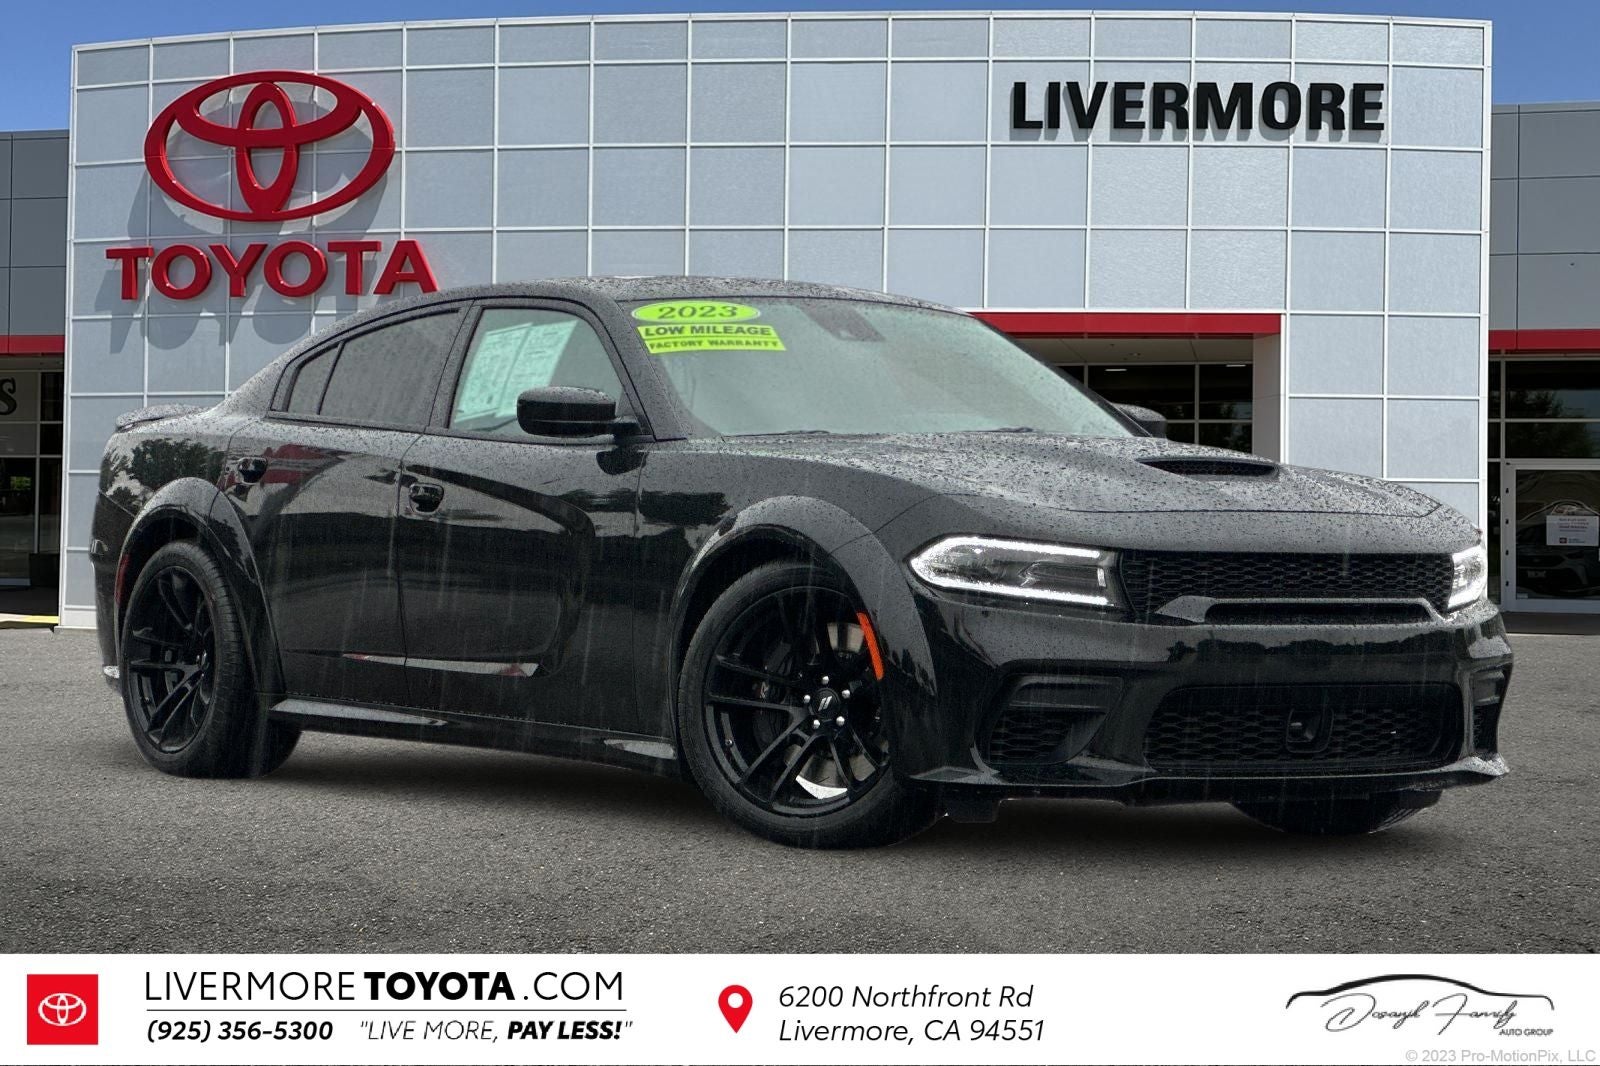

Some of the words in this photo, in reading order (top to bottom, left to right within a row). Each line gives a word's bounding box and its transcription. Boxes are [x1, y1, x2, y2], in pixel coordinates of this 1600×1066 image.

[1012, 81, 1385, 131] LIVERMORE
[106, 240, 439, 300] TOYOTA
[658, 305, 738, 319] 2023
[645, 326, 685, 337] LOW
[690, 325, 772, 336] MILEAGE
[649, 340, 703, 350] FACTORY
[708, 339, 778, 348] WARRANTY
